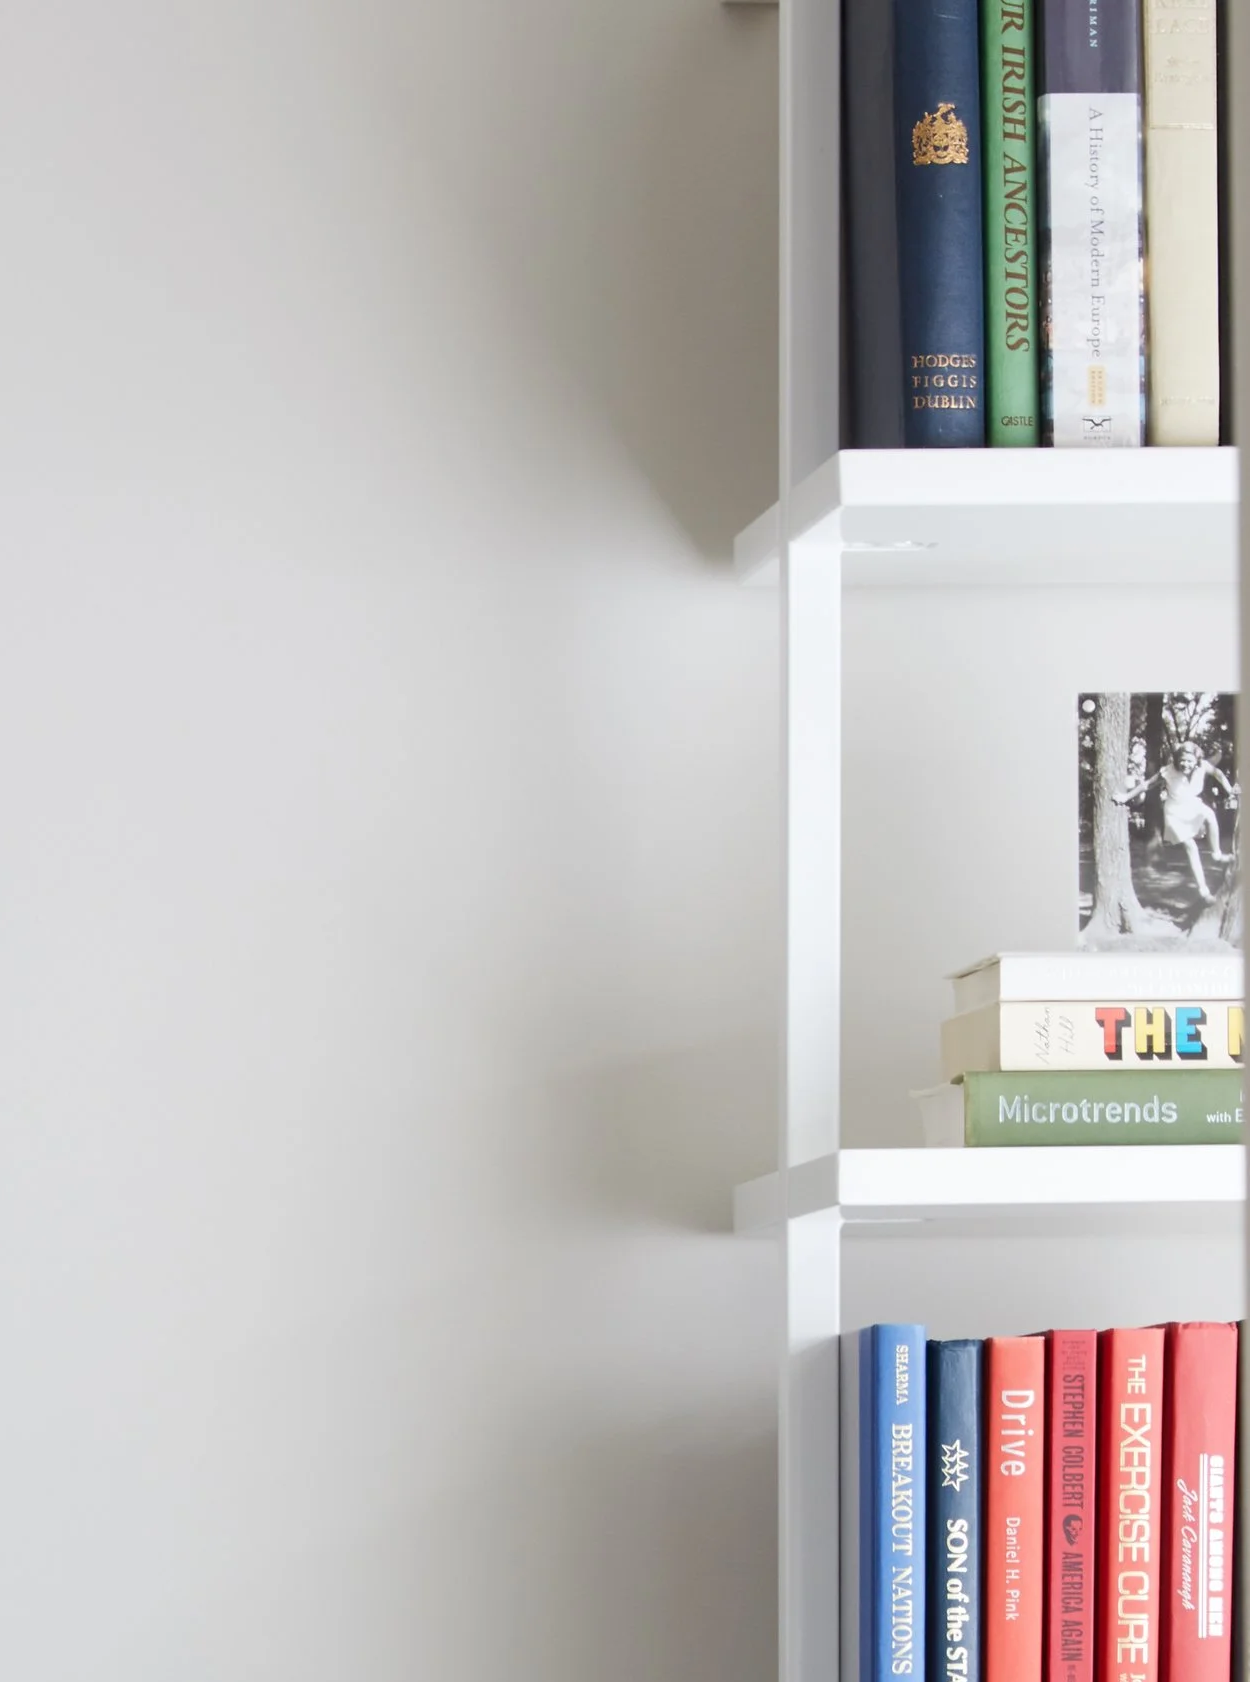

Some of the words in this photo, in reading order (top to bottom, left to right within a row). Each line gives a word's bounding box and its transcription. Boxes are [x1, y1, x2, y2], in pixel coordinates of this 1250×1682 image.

[1001, 44, 1027, 143] IRISH
[1089, 107, 1103, 121] A
[1085, 127, 1104, 189] History
[1090, 195, 1104, 216] of
[1002, 151, 1030, 353] ANCESTORS
[1090, 219, 1105, 288] Modern
[1086, 294, 1105, 358] Europe
[912, 354, 977, 369] HODGES
[912, 374, 978, 389] FIGGIS
[913, 394, 977, 409] DUBLIN
[1000, 415, 1035, 427] CASTLE
[1095, 1007, 1207, 1060] THE
[998, 1095, 1178, 1124] Microtrends
[1206, 1110, 1232, 1123] with
[896, 1344, 909, 1406] SHARMA
[1127, 1354, 1146, 1395] THE
[1000, 1388, 1036, 1477] Drive
[1062, 1373, 1085, 1439] STEPHEN
[891, 1422, 914, 1557] BREAKOUT
[1061, 1445, 1084, 1511] COLBERT
[1118, 1402, 1152, 1564] EXERCISE
[1177, 1478, 1198, 1523] Jack
[946, 1517, 968, 1573] SON
[1005, 1516, 1021, 1564] Daniel
[946, 1577, 970, 1604] of
[1005, 1569, 1020, 1585] H.
[1061, 1551, 1083, 1614] AMERICA
[1177, 1526, 1198, 1612] Cavanaugh
[891, 1566, 914, 1675] NATIONS
[946, 1605, 970, 1643] the
[1005, 1588, 1021, 1621] Pink
[1117, 1570, 1150, 1665] CURE
[1061, 1619, 1083, 1662] AGAIN
